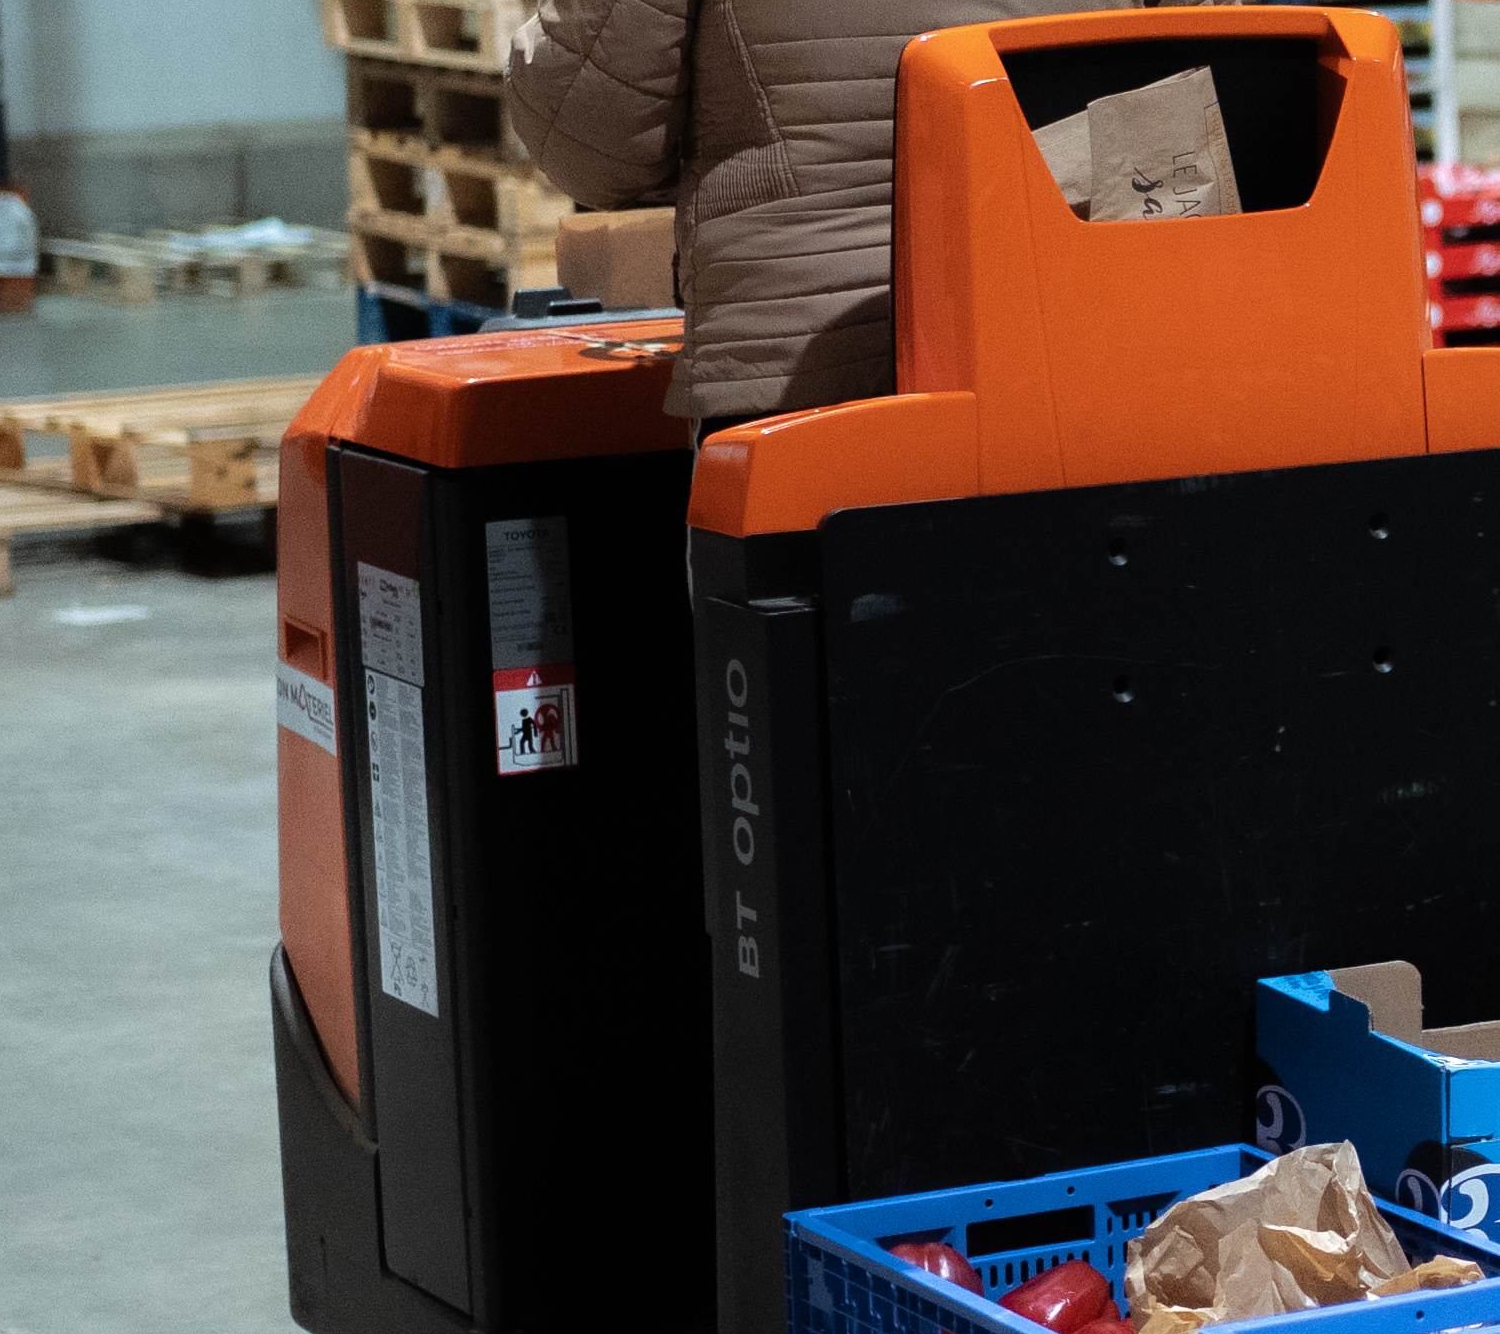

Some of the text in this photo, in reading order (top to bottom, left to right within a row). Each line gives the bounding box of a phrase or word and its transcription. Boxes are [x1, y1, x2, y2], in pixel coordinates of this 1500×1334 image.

[1172, 150, 1198, 179] LE
[503, 528, 550, 542] TOYOTA
[735, 889, 761, 979] BT
